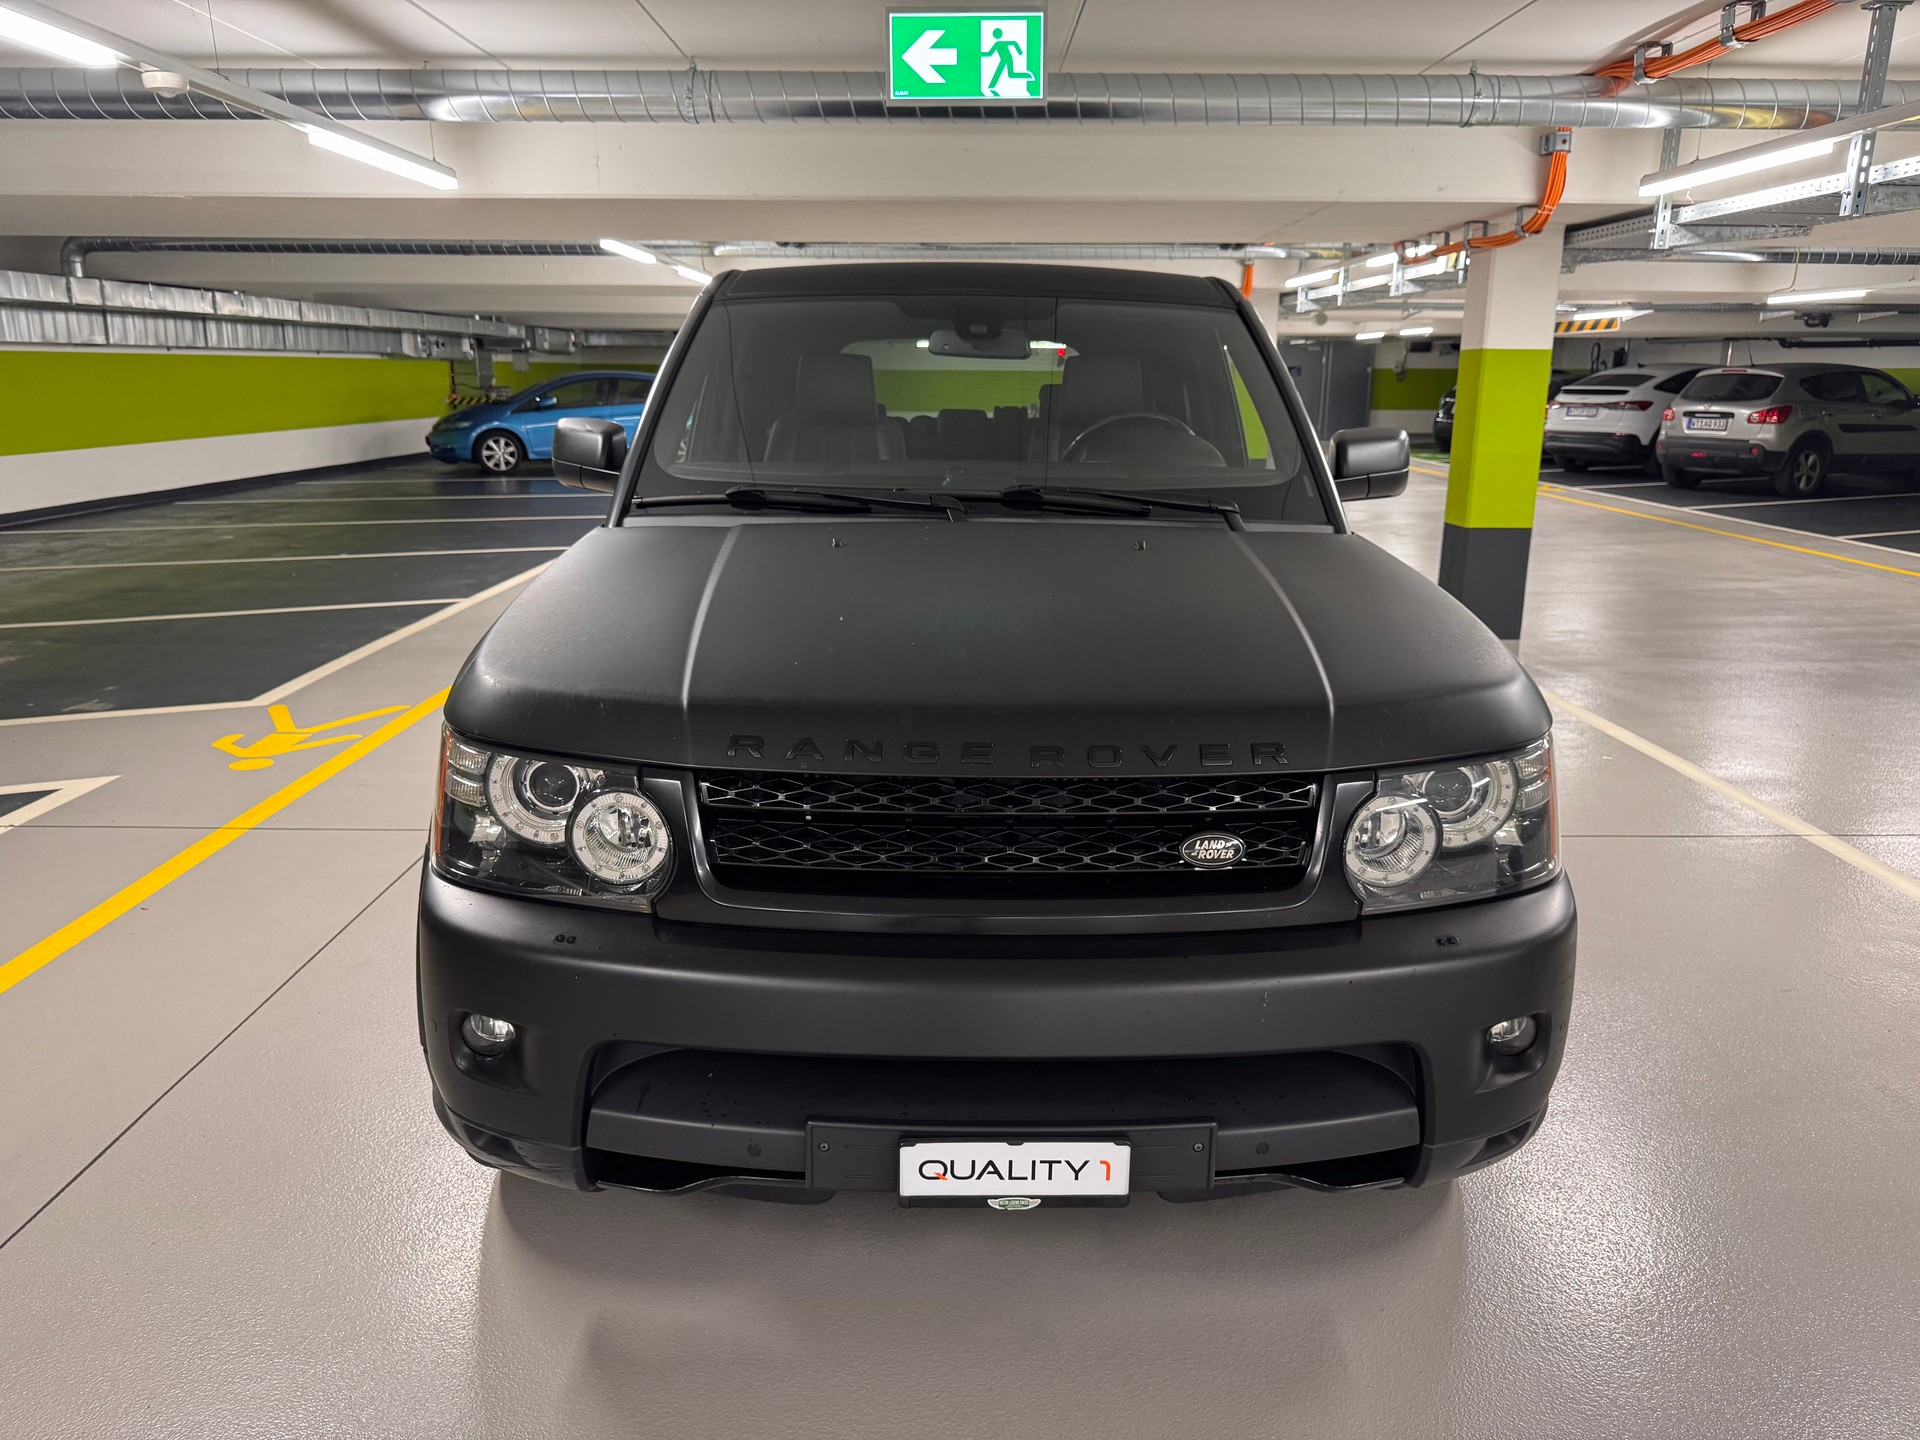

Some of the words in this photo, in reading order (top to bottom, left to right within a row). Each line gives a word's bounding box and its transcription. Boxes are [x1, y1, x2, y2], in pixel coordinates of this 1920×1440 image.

[727, 733, 995, 765] RANGE
[1030, 742, 1289, 768] ROVER
[1195, 840, 1226, 850] LAND
[1198, 849, 1235, 859] ROVER
[918, 1160, 1091, 1181] QUALITY
[1099, 1160, 1111, 1181] 1
